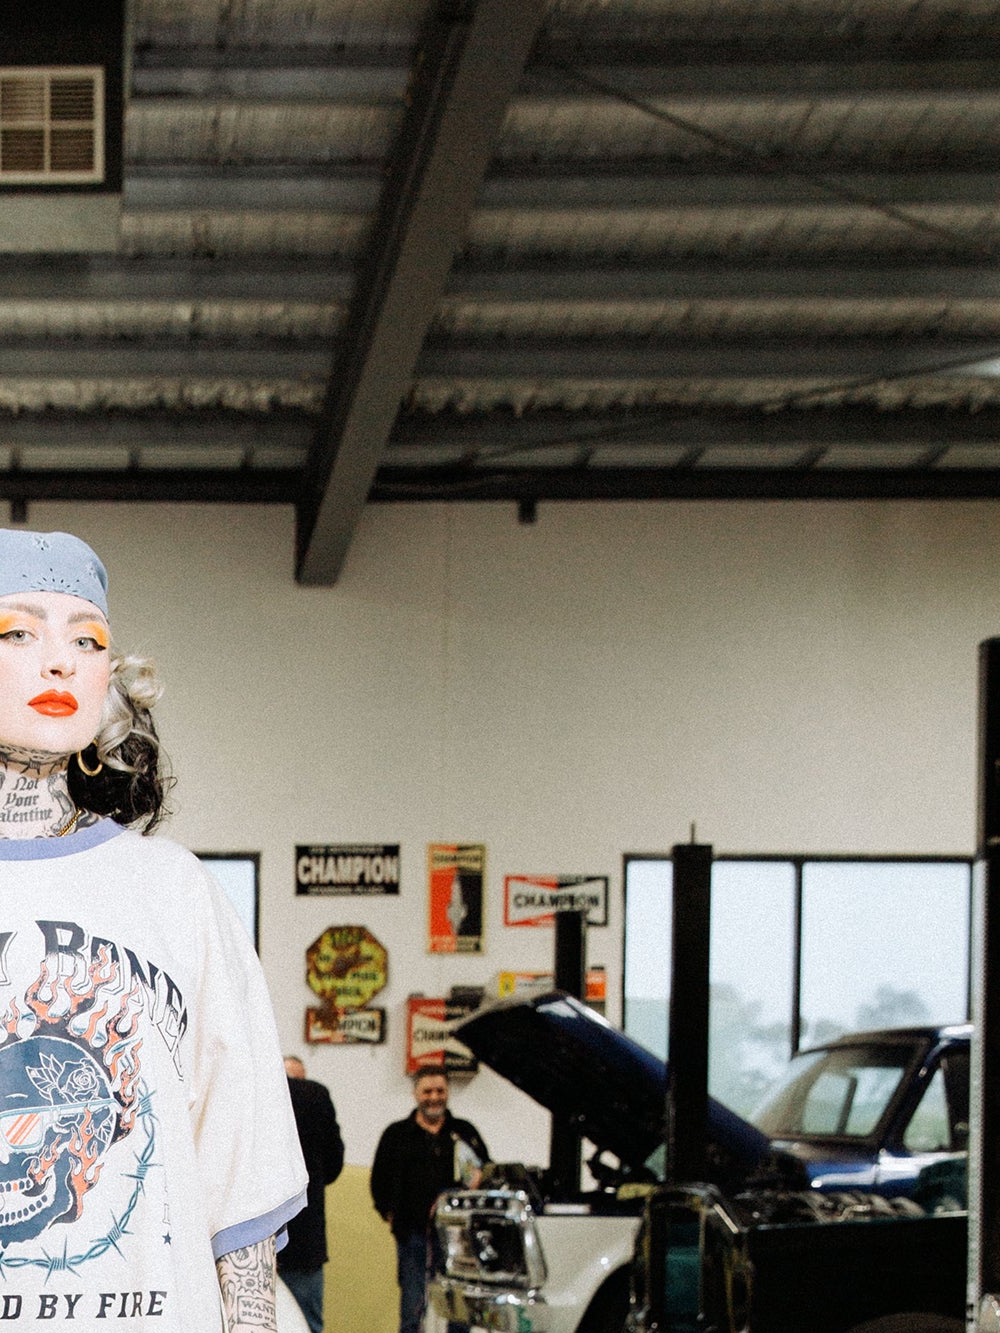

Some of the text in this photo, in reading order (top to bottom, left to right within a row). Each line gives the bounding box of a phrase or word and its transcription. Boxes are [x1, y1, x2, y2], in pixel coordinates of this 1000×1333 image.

[11, 776, 39, 791] Not
[2, 792, 39, 810] Your
[298, 855, 400, 885] CHAMPION
[513, 892, 601, 909] CHAMPION
[36, 1293, 83, 1320] BY
[95, 1290, 168, 1319] FIRE
